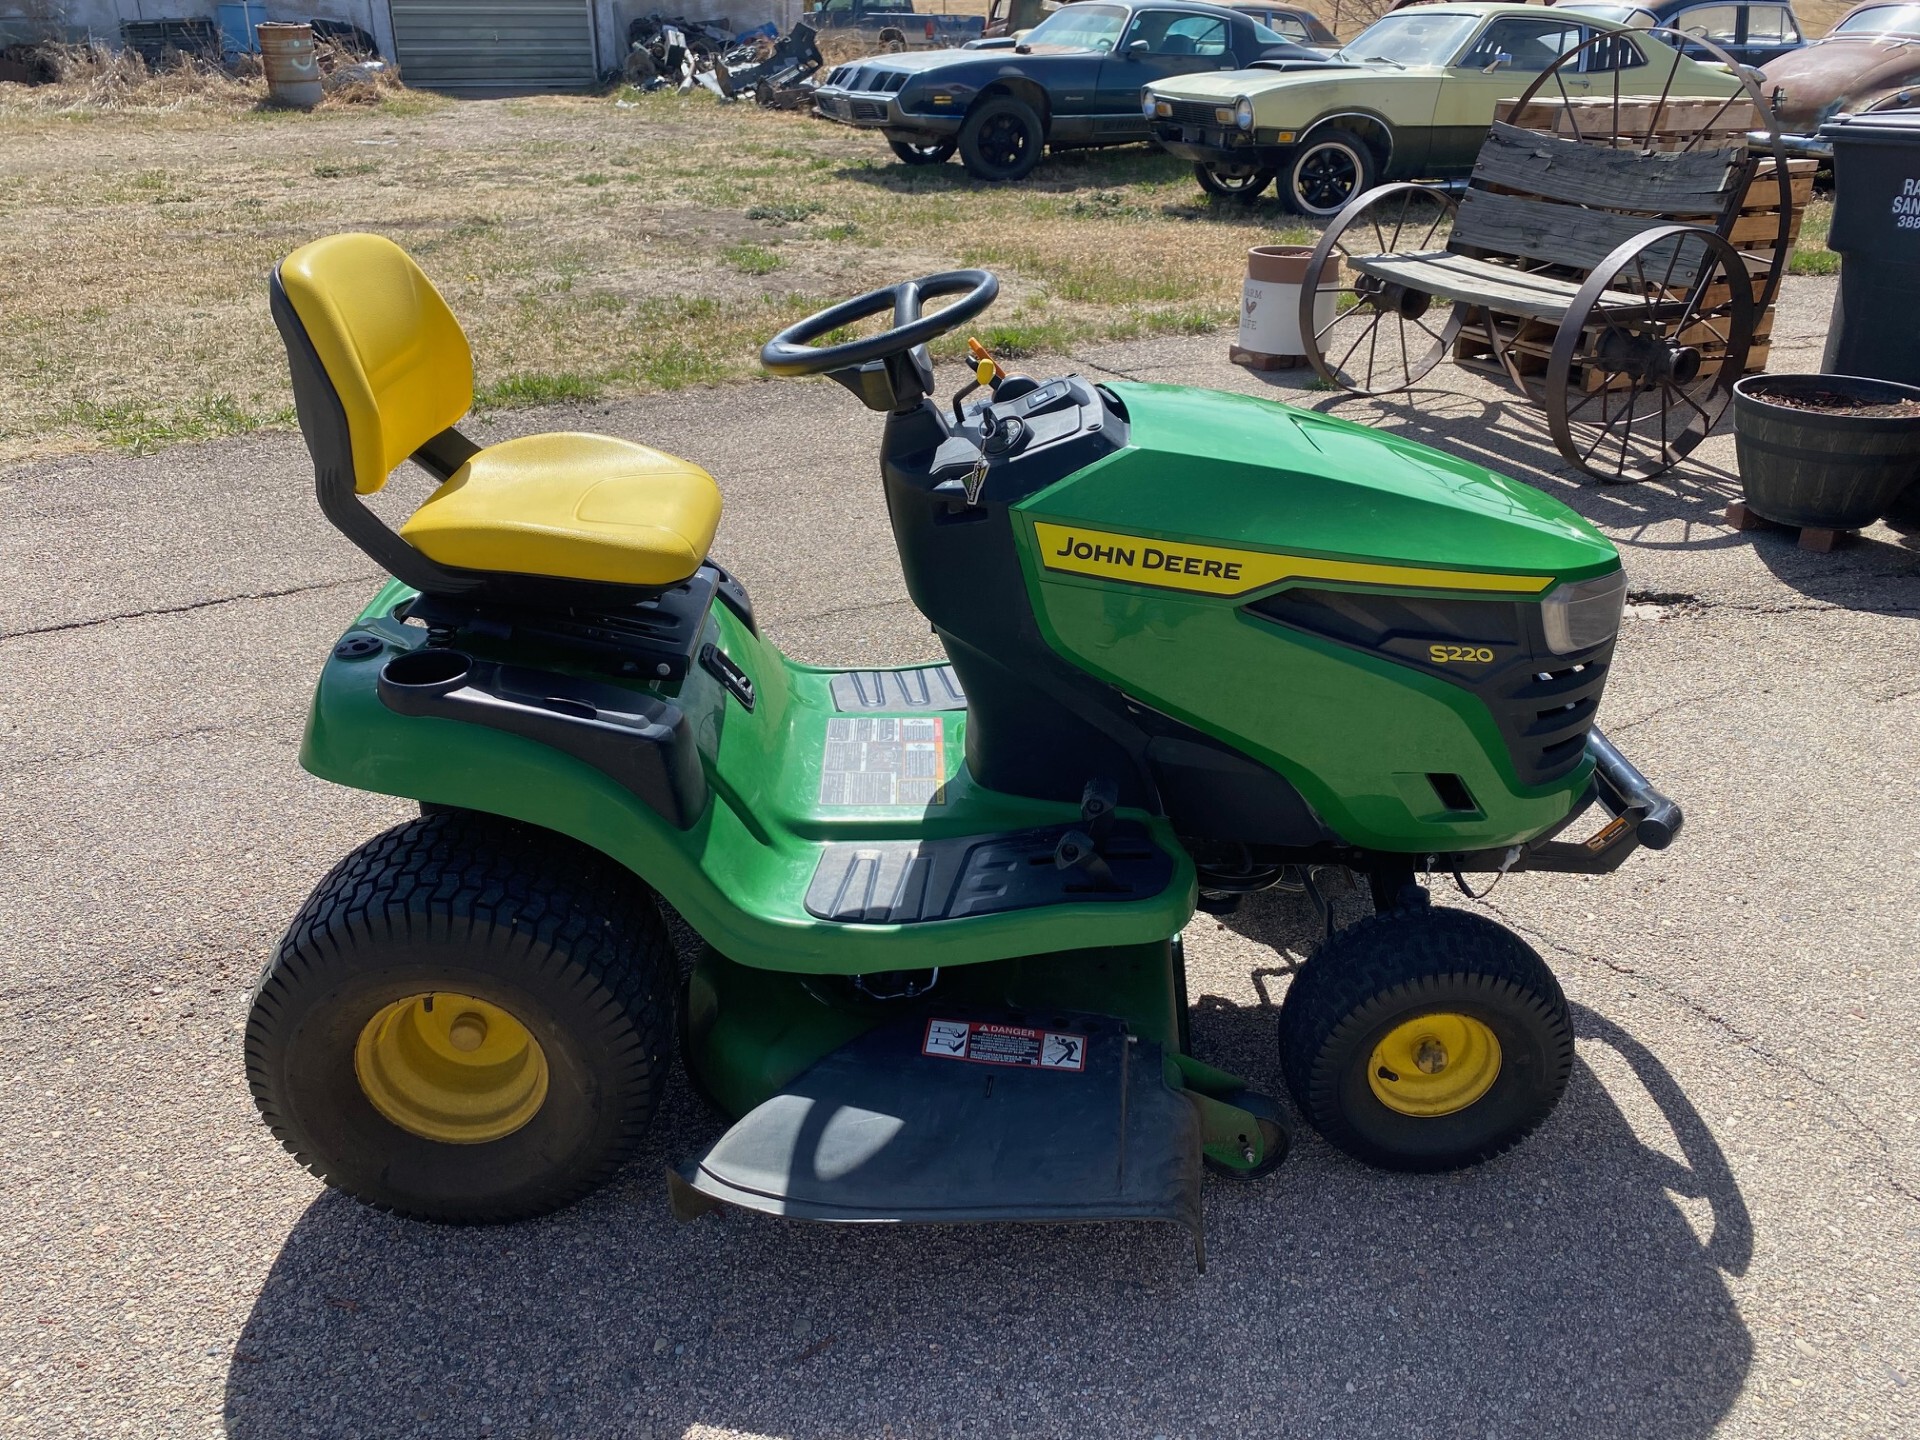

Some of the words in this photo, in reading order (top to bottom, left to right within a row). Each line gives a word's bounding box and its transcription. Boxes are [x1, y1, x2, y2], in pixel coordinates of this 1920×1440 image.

[1892, 196, 1920, 215] SAN
[1897, 215, 1920, 229] 388
[1056, 536, 1136, 567] JOHN
[1141, 547, 1243, 581] DEERE
[1429, 644, 1494, 663] S220
[990, 1025, 1035, 1037] DANGER
